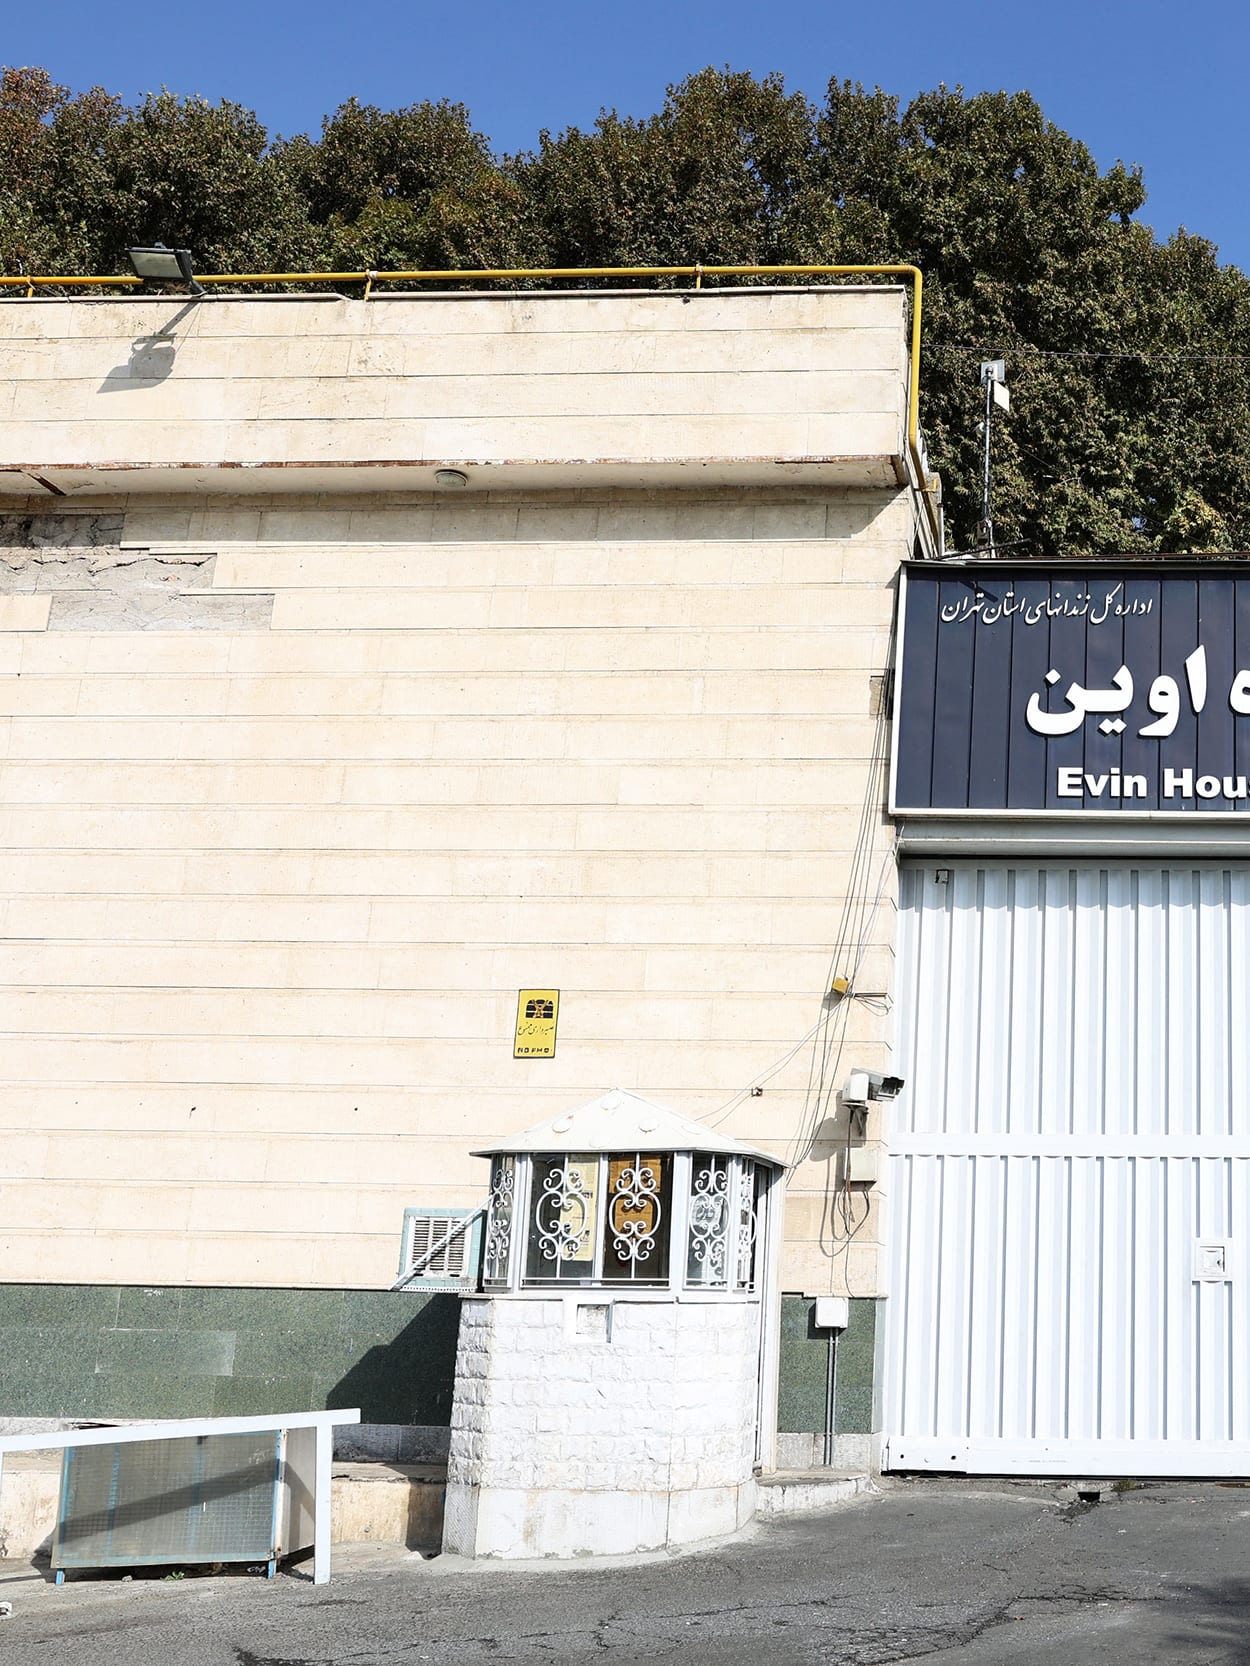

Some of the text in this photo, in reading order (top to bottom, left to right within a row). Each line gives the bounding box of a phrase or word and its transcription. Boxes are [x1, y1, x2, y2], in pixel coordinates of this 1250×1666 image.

[941, 582, 1153, 625] اداره کل زندانهای استان تهران
[1026, 644, 1207, 736] اوین
[1057, 767, 1148, 798] Evin
